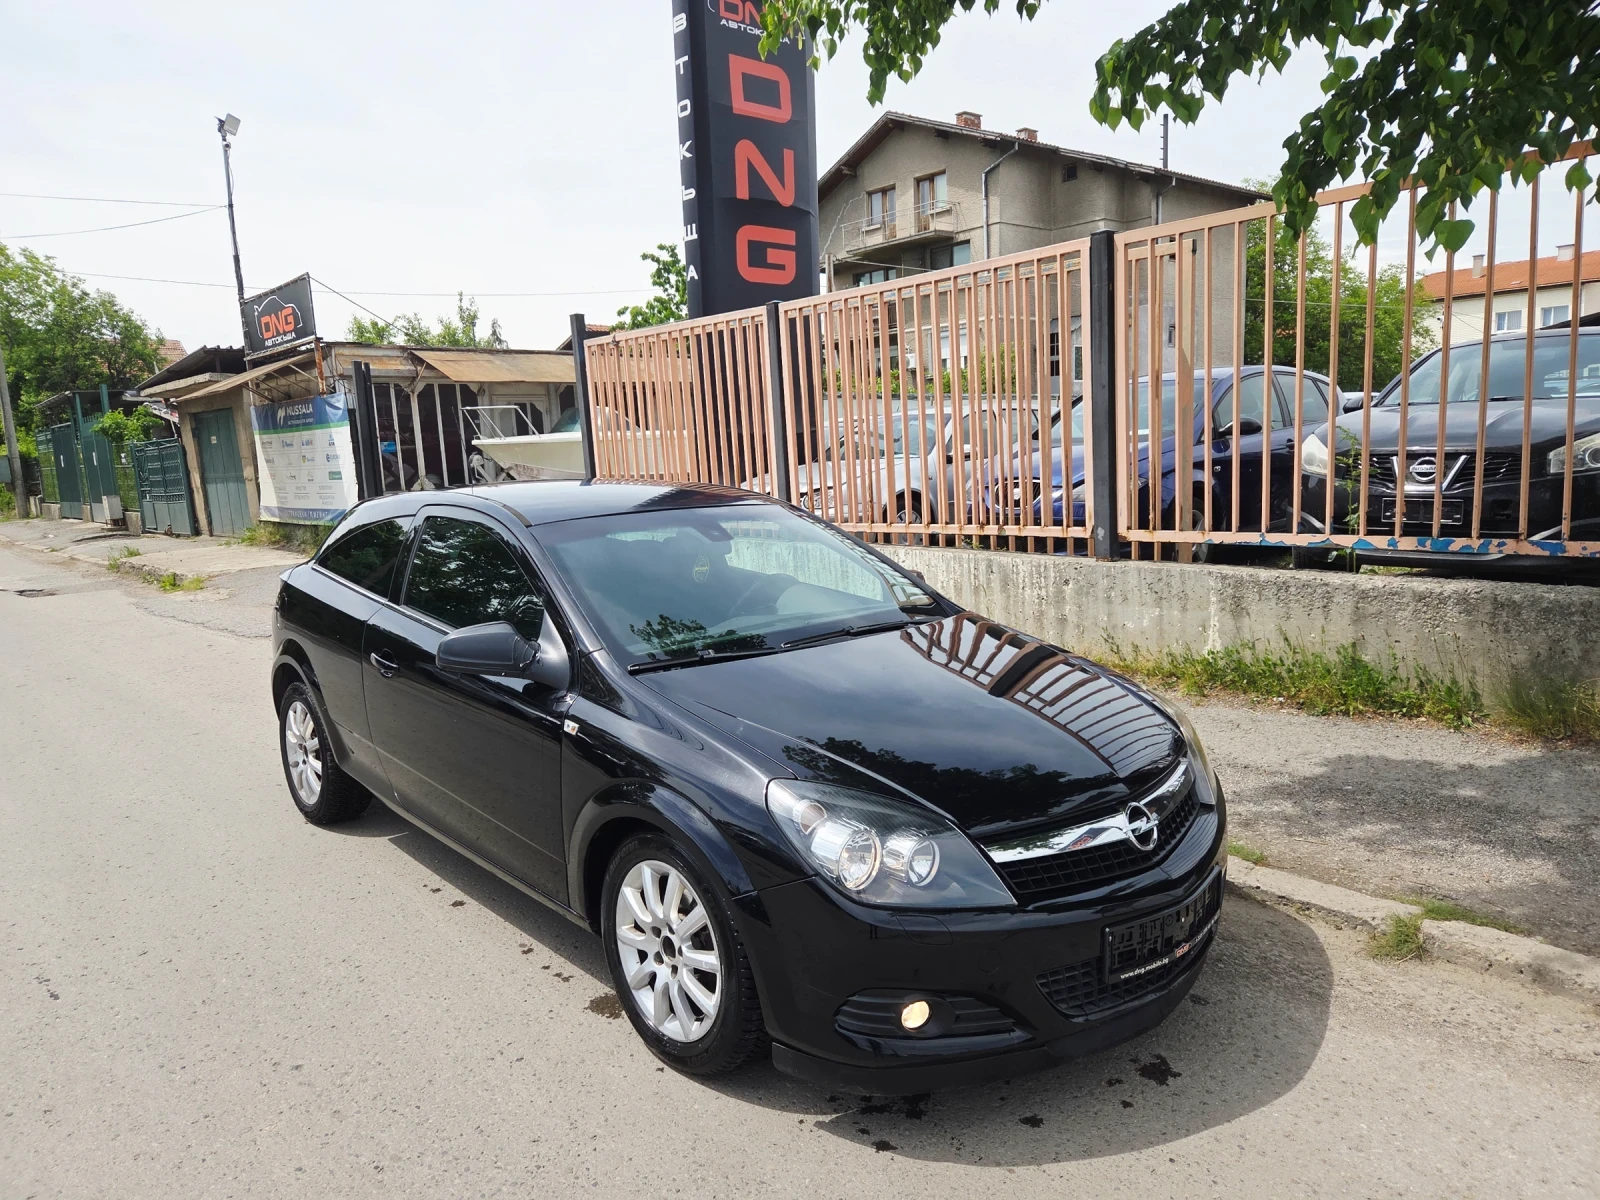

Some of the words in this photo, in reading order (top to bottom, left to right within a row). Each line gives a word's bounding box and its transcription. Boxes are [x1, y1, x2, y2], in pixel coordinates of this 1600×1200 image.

[728, 53, 796, 285] DNG
[260, 306, 295, 340] DNG
[286, 402, 314, 417] MUSSALA
